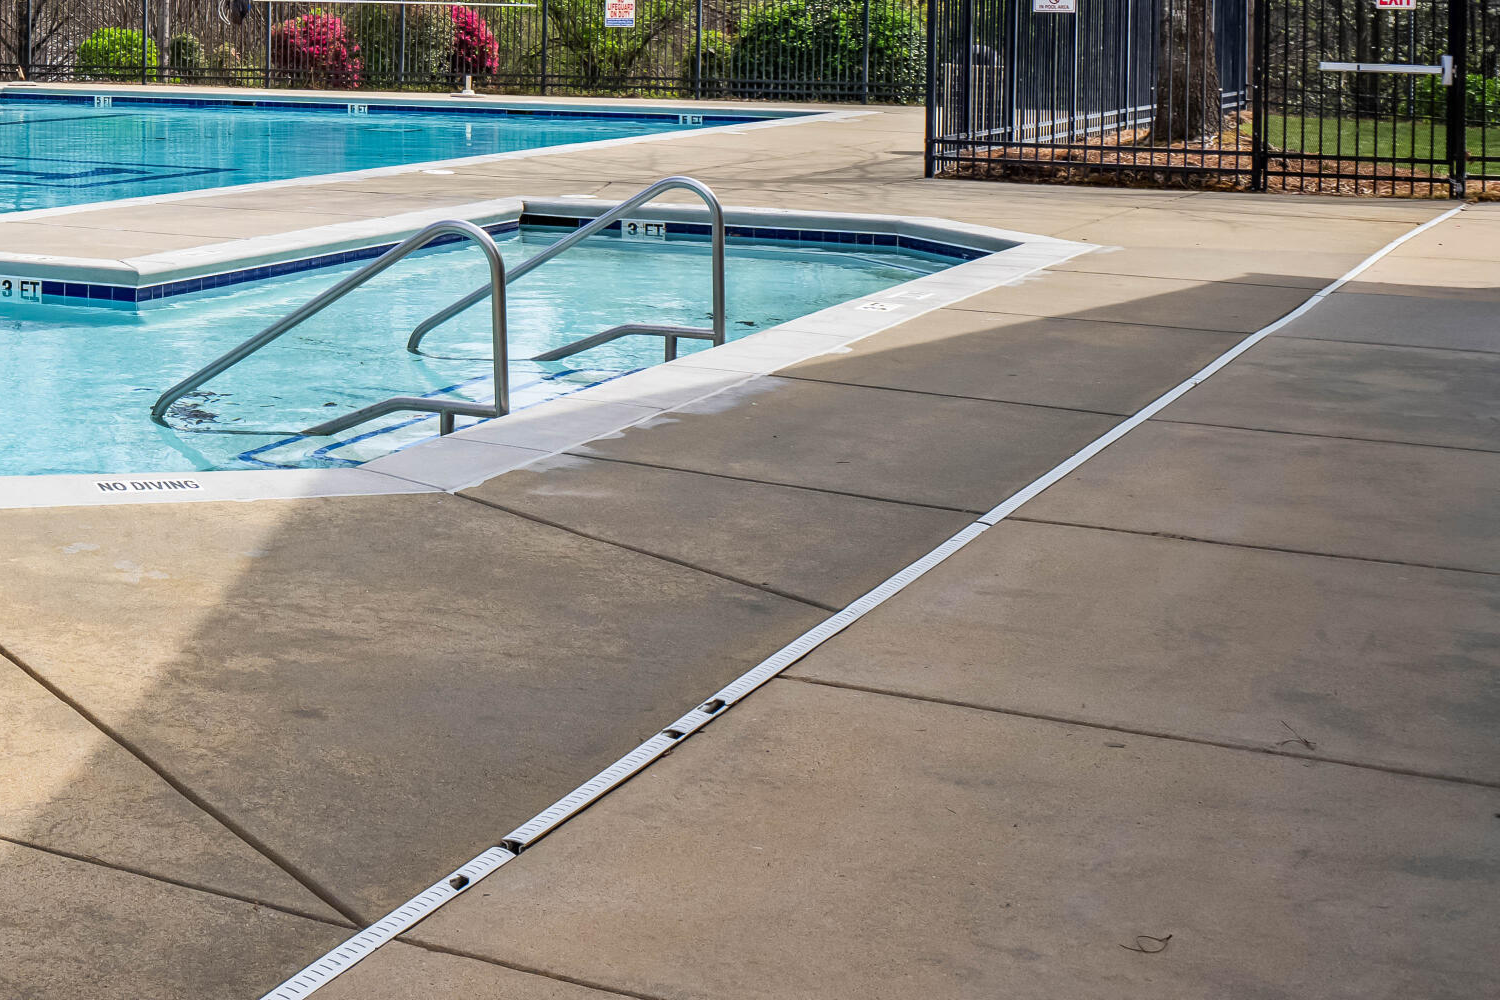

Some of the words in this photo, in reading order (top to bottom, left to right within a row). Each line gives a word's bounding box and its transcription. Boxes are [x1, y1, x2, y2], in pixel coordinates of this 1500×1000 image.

[607, 3, 634, 11] LIFEGUARD
[610, 10, 618, 18] ON
[618, 10, 630, 18] DUTY
[1, 279, 13, 298] 3
[97, 482, 128, 492] NO
[130, 480, 201, 491] DIVING
